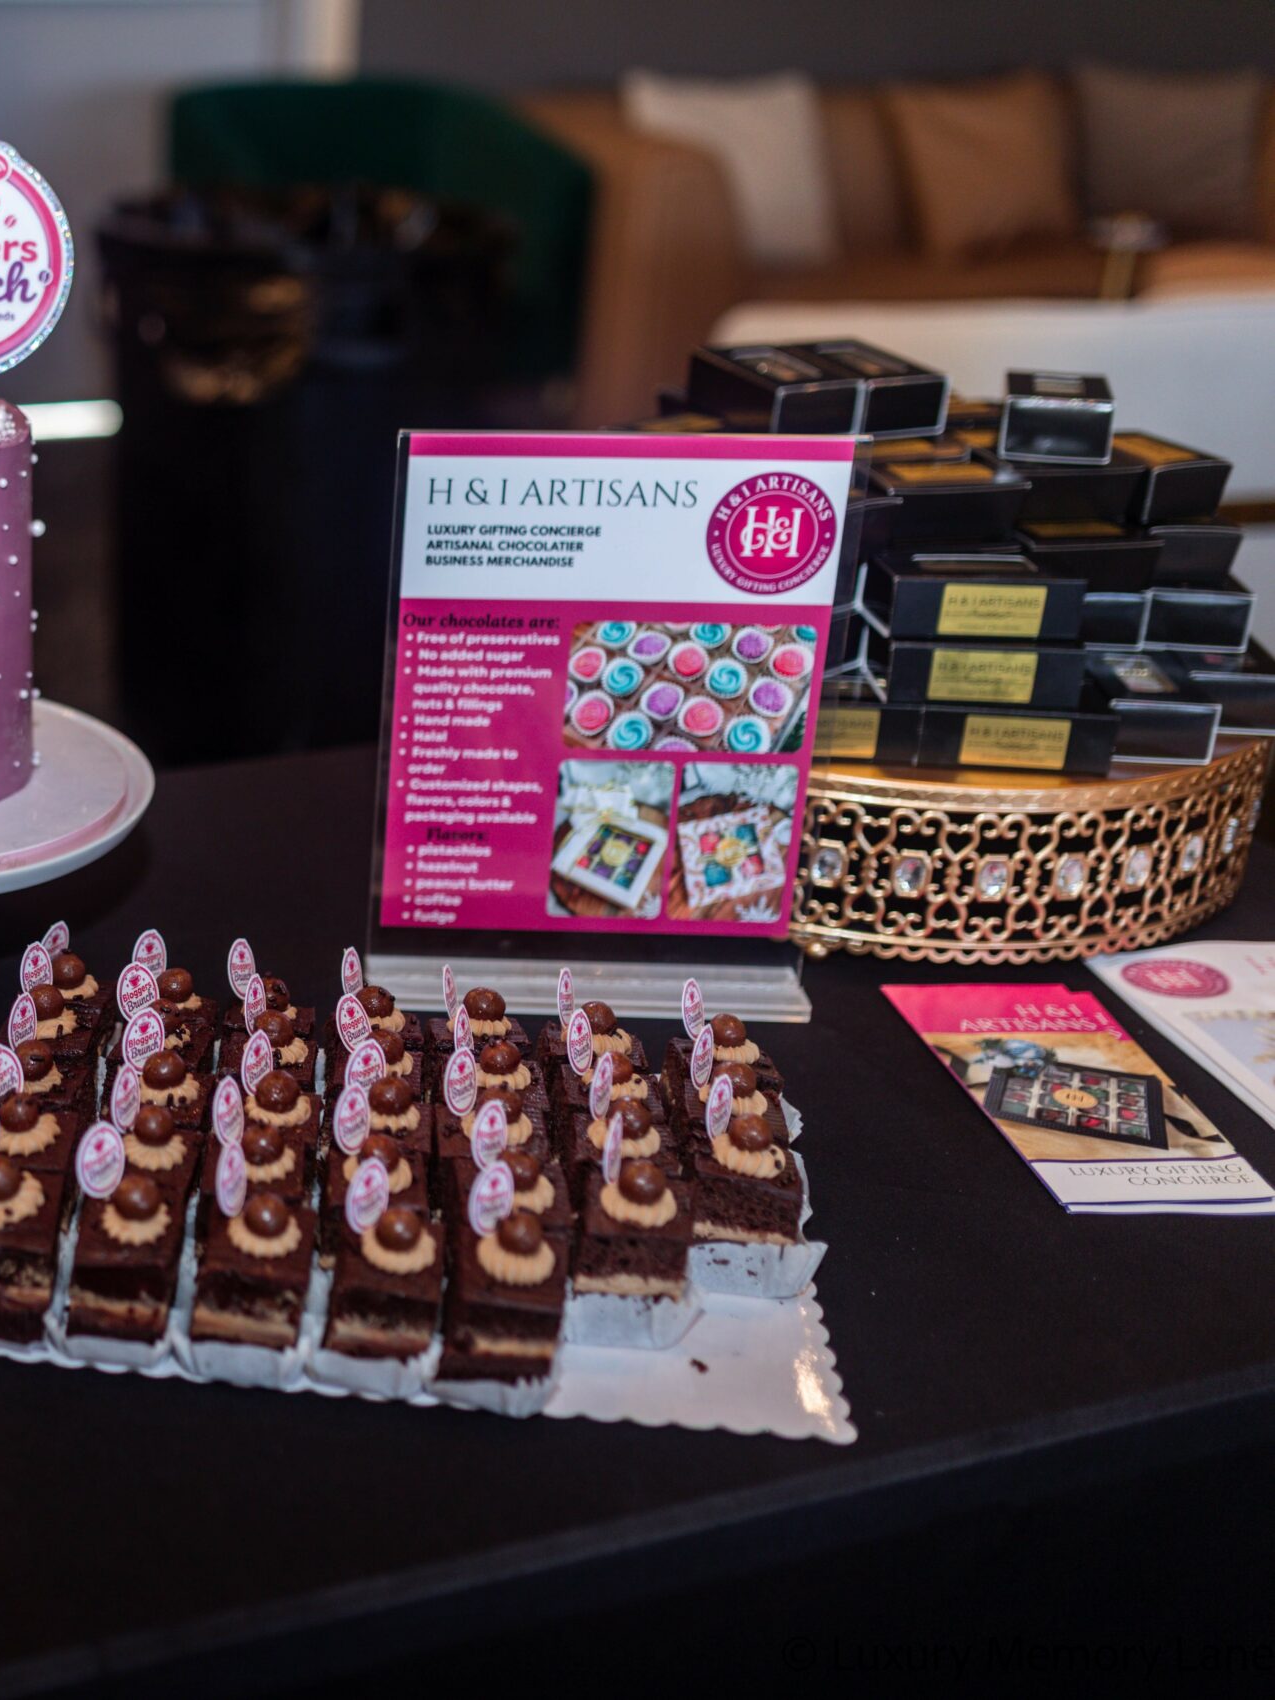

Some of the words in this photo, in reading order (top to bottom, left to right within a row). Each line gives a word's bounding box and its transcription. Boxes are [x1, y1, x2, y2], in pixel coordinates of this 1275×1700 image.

[428, 478, 453, 505] H
[464, 478, 489, 506] &
[500, 479, 509, 506] I
[521, 479, 699, 508] ARTISANS
[715, 507, 732, 521] H
[728, 494, 743, 507] &
[741, 484, 752, 498] I
[755, 475, 833, 522] ARTISANS
[427, 525, 477, 536] LUXURY
[479, 525, 528, 536] GIFTING
[530, 526, 602, 537] CONCIERGE
[426, 540, 495, 551] ARTISANAL
[498, 541, 584, 552] CHOCOLATIER
[425, 556, 484, 567] BUSINESS
[487, 556, 574, 567] MERCHANDISE
[735, 575, 777, 593] GIFTING
[777, 545, 830, 591] CONCIERGE
[402, 612, 436, 628] Our
[439, 613, 525, 628] chocolates
[528, 616, 560, 629] are:
[416, 632, 447, 644] Free
[449, 632, 465, 644] of
[466, 633, 560, 647] preservatives
[418, 649, 438, 661] No
[440, 649, 484, 662] added
[485, 651, 525, 665] sugar
[417, 665, 456, 677] Made
[457, 665, 488, 678] with
[489, 666, 553, 680] premium
[413, 682, 461, 696] quality
[462, 683, 536, 696] chocolate,
[412, 698, 443, 710] nuts
[445, 698, 455, 711] &
[457, 698, 503, 714] fillings
[414, 714, 451, 726] Hand
[452, 715, 491, 727] made
[413, 730, 448, 743] Halal
[411, 746, 461, 761] Freshly
[462, 748, 501, 760] made
[503, 748, 518, 760] to
[407, 762, 446, 774] order
[409, 778, 490, 791] Customized
[492, 780, 543, 794] shapes,
[406, 794, 456, 808] flavors,
[458, 795, 499, 808] colors
[404, 810, 475, 826] packaging
[476, 811, 538, 824] available
[415, 877, 466, 891] peanut
[468, 877, 514, 891] butter
[122, 982, 153, 1002] Bloggers
[126, 987, 155, 1013] Brunch
[341, 1016, 365, 1032] Bloggers
[960, 1017, 1097, 1032] ARTISANS
[128, 1030, 159, 1048] Bloggers
[130, 1038, 159, 1060] Brunch
[1069, 1165, 1149, 1176] LUXURY
[1156, 1163, 1242, 1175] GIFTING
[1127, 1174, 1254, 1186] CONCIERGE
